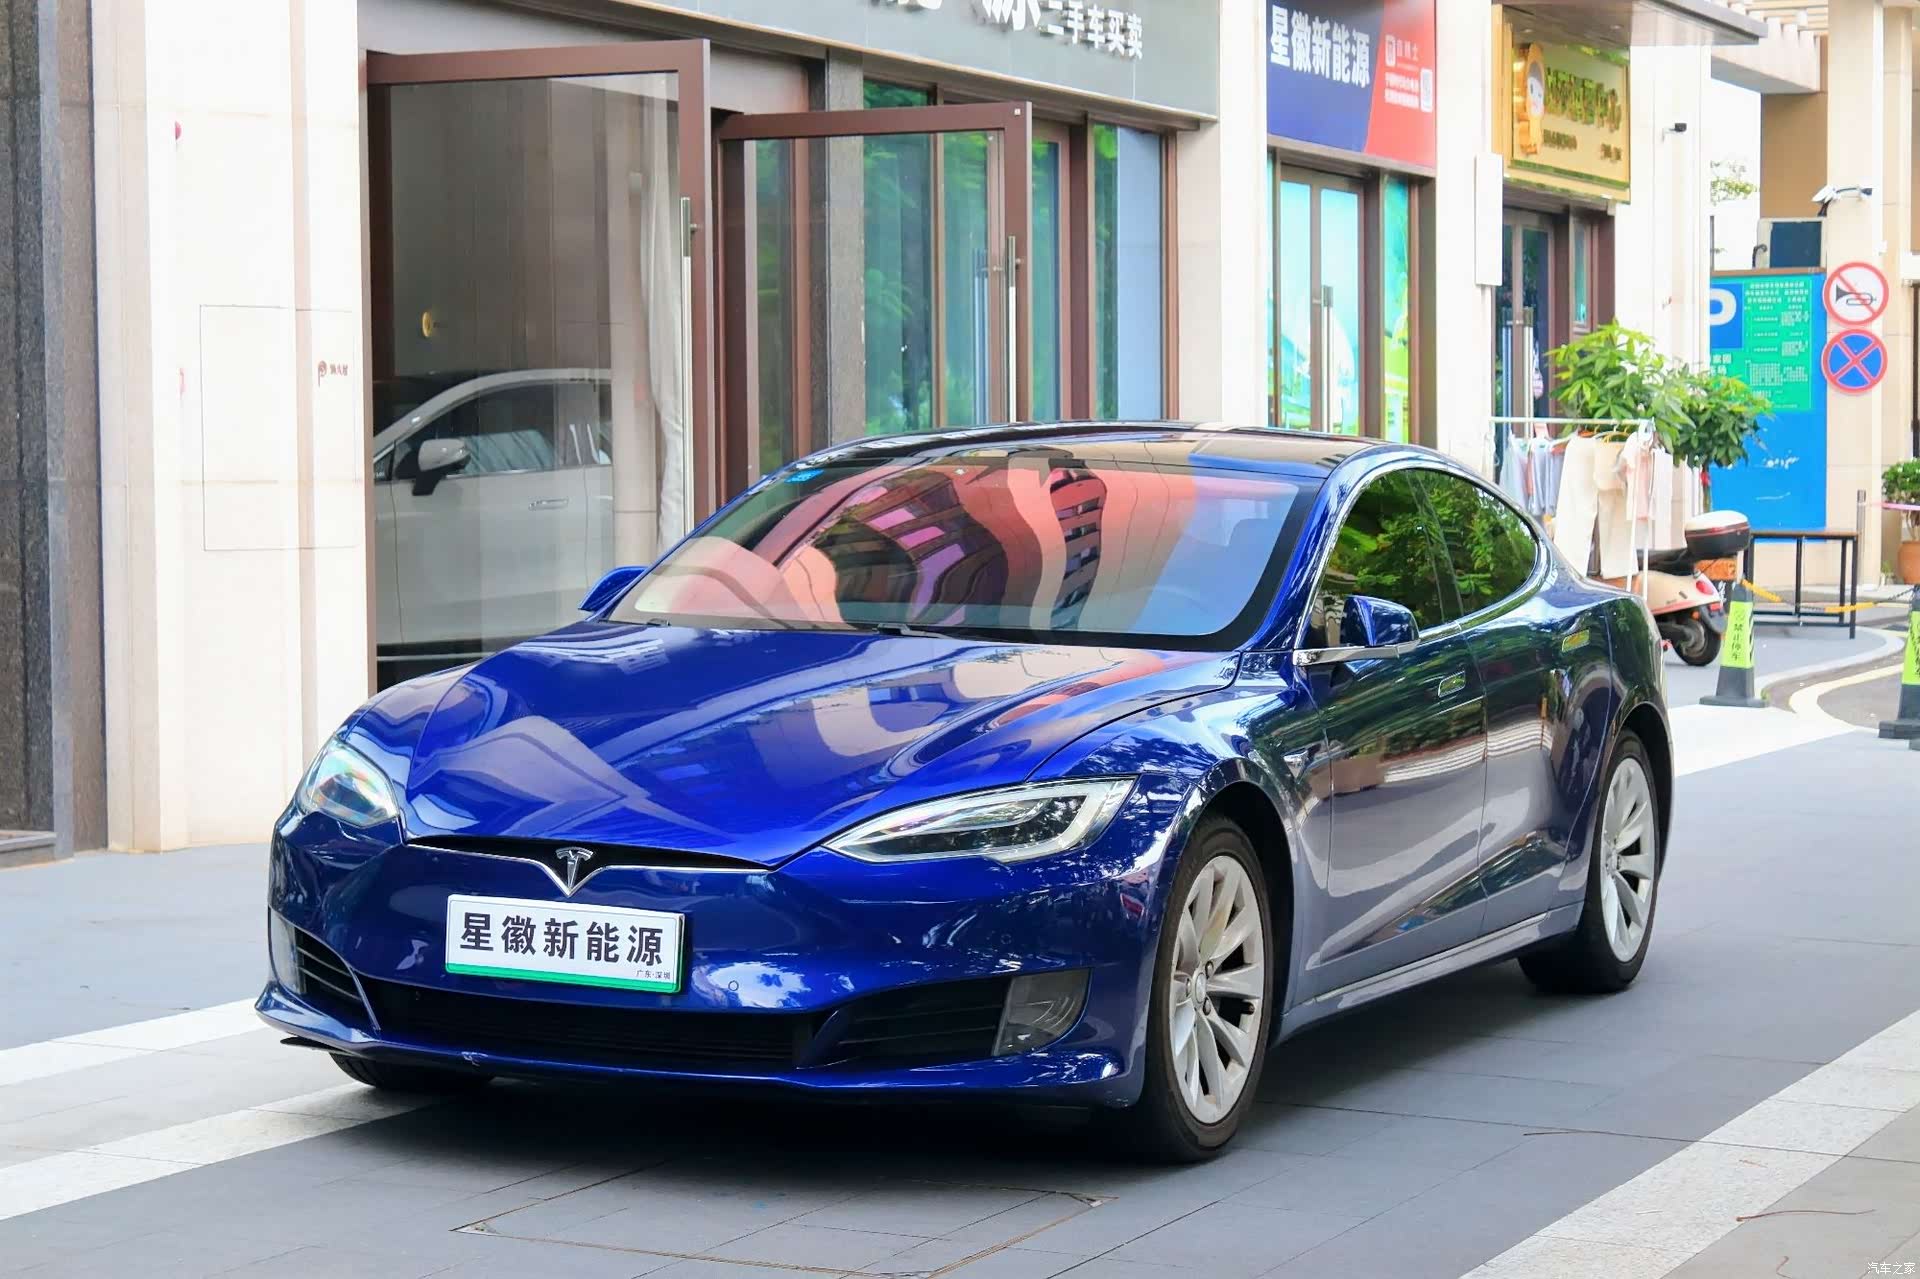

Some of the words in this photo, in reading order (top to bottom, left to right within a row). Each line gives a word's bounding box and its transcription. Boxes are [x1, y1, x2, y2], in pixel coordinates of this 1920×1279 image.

[1047, 0, 1143, 60] 二手车买卖
[1270, 4, 1371, 88] 星徽新能源
[460, 912, 663, 967] 星徽新能源
[636, 970, 671, 981] 广东·深圳
